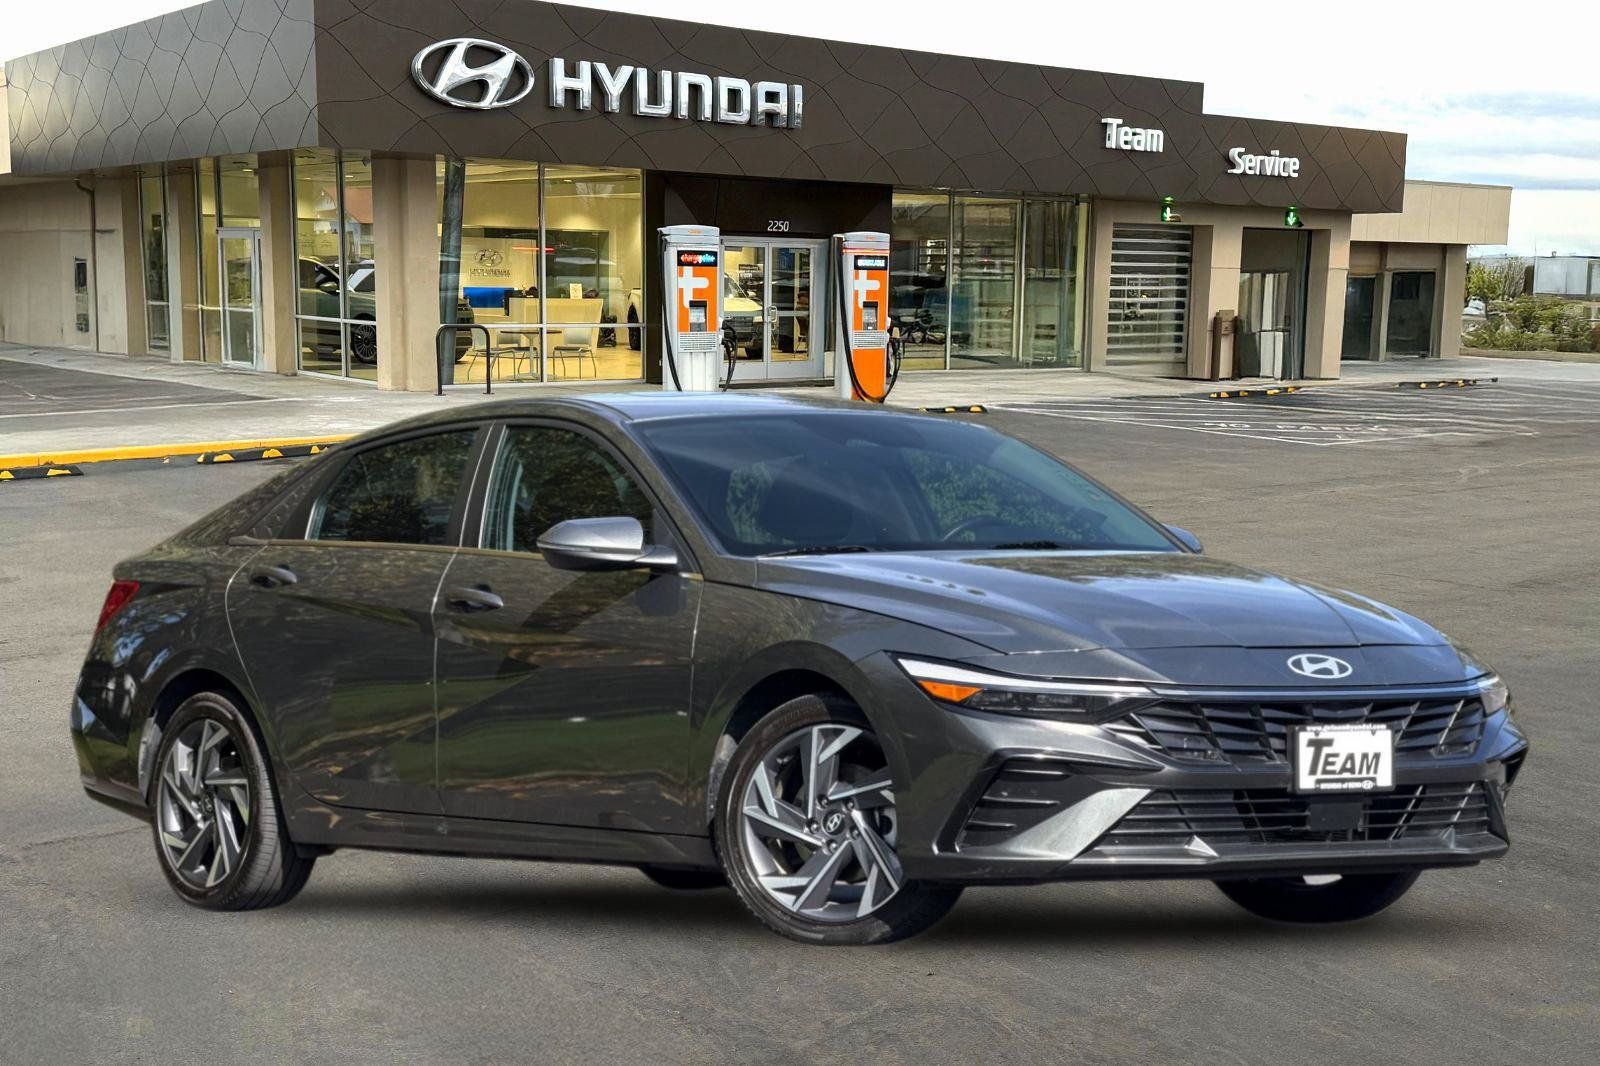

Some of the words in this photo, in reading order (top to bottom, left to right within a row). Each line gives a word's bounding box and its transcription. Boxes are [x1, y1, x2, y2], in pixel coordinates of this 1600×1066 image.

[549, 57, 803, 129] HYUNDAI
[1101, 117, 1164, 153] Team
[1227, 147, 1300, 178] Service
[767, 220, 789, 232] 2250
[1306, 738, 1381, 776] TEAM
